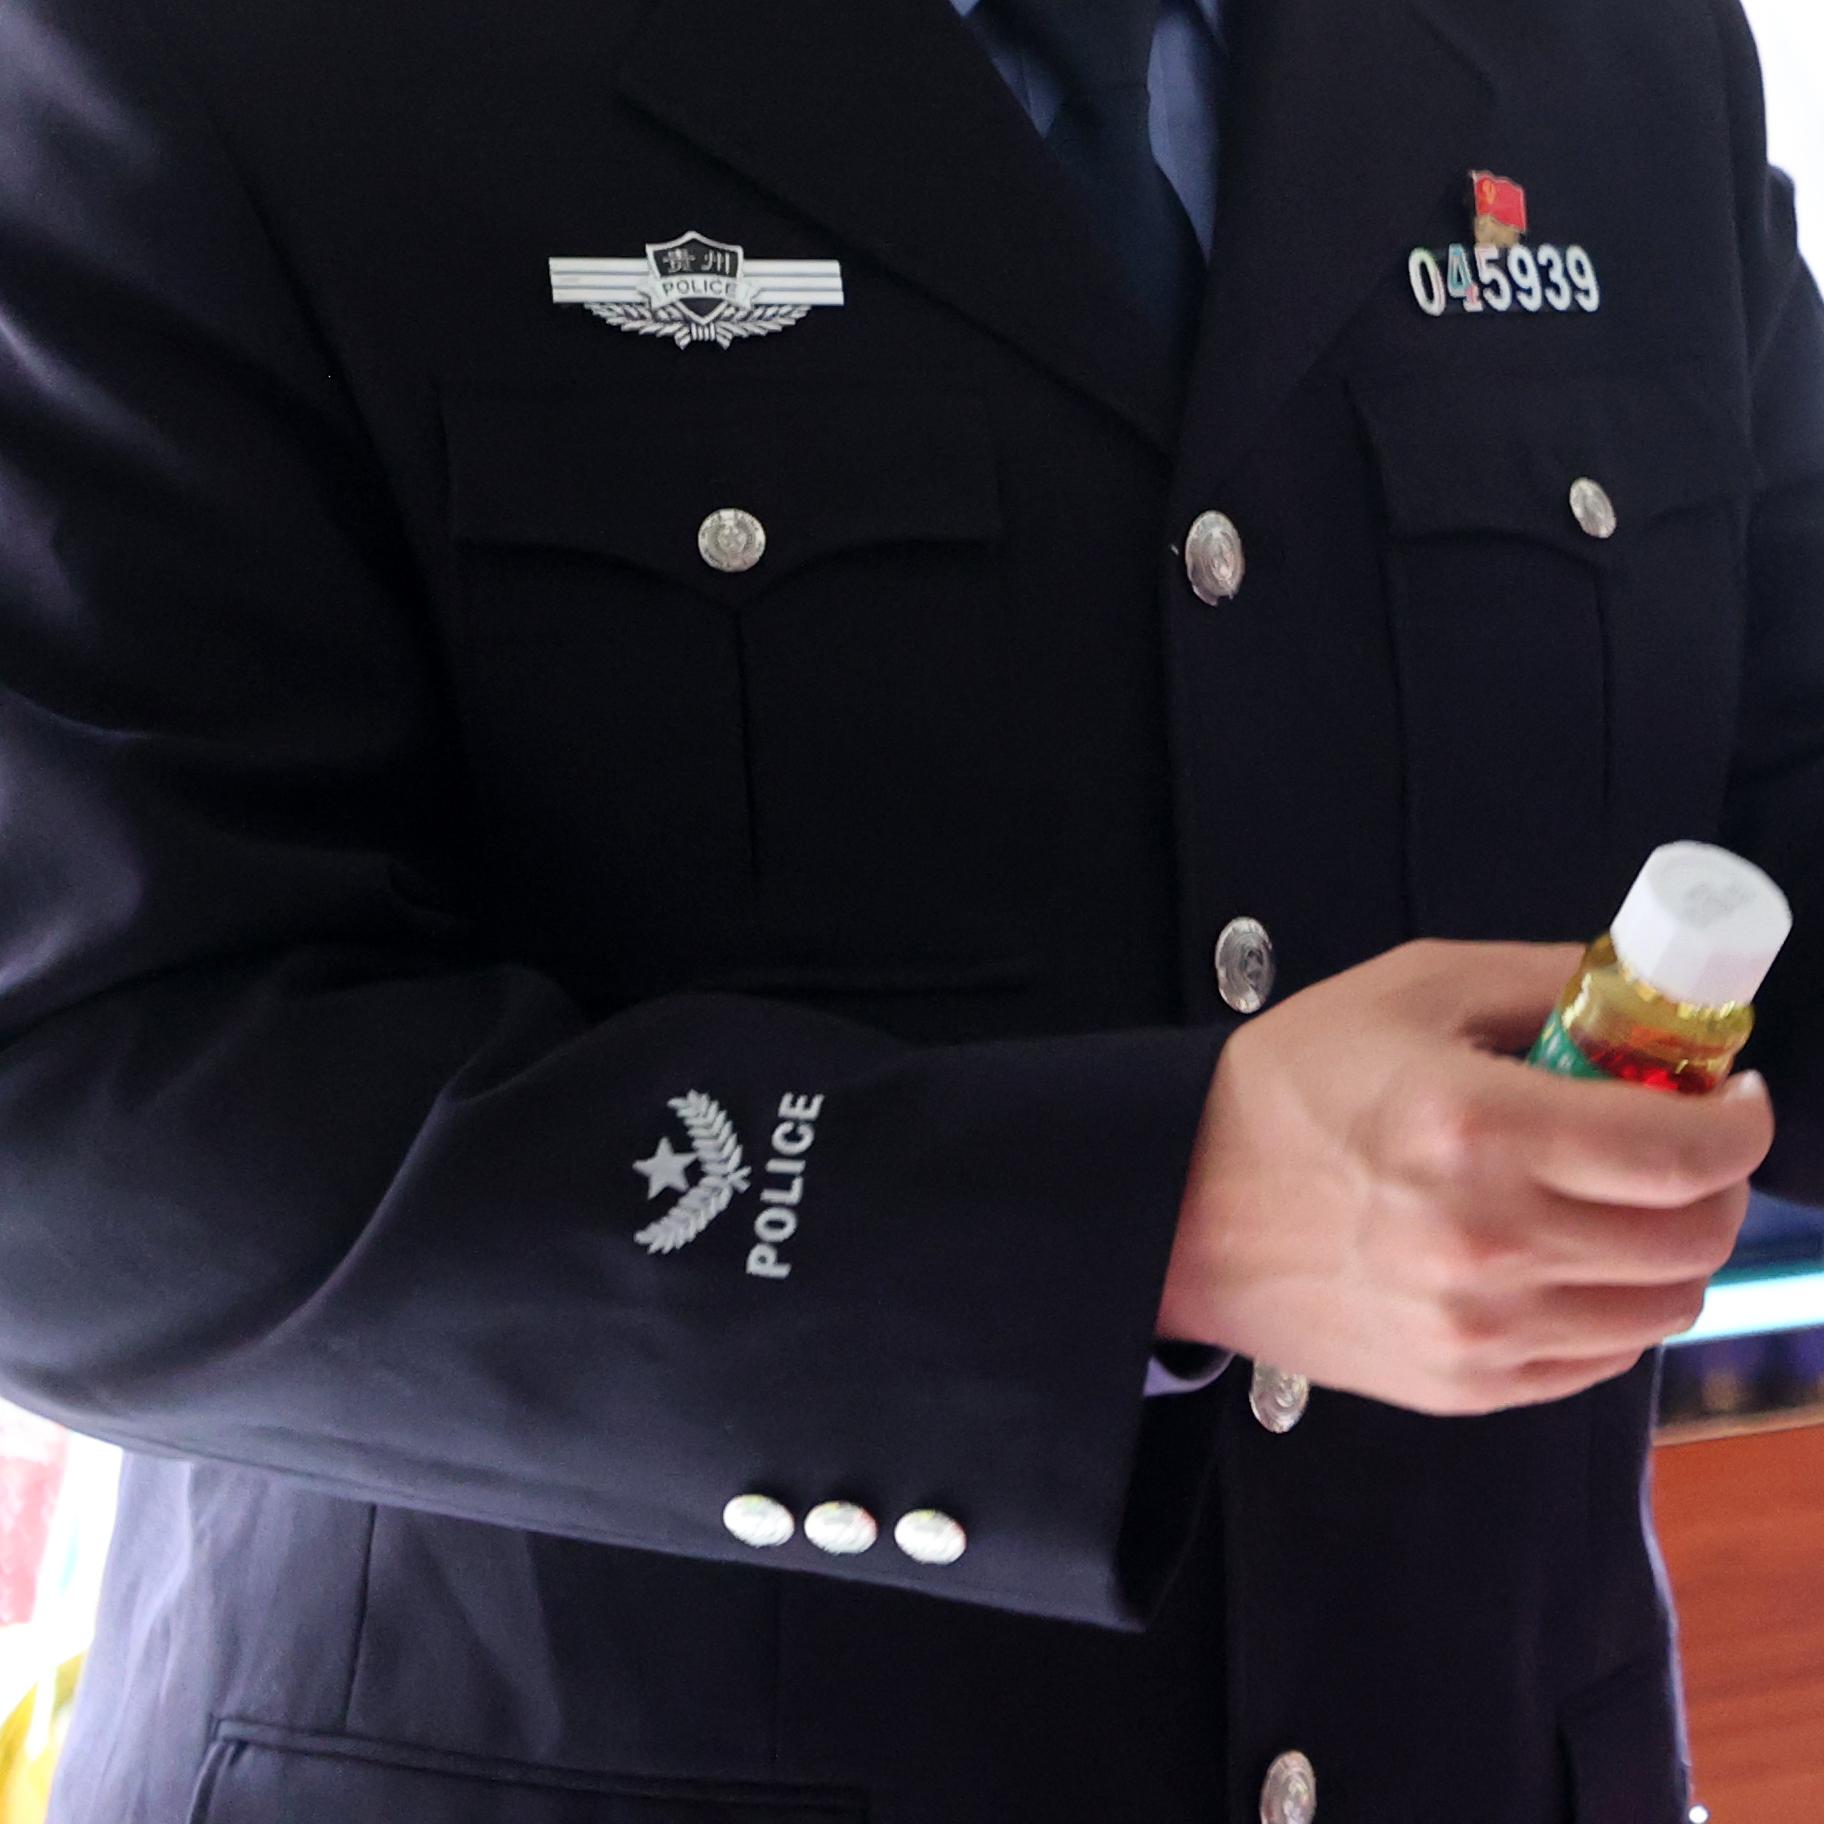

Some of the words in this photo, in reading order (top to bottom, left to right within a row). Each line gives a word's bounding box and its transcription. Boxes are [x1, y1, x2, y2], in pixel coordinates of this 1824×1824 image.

[661, 279, 737, 297] POLICE
[1408, 242, 1600, 317] 045939
[745, 1091, 825, 1280] POLICE
